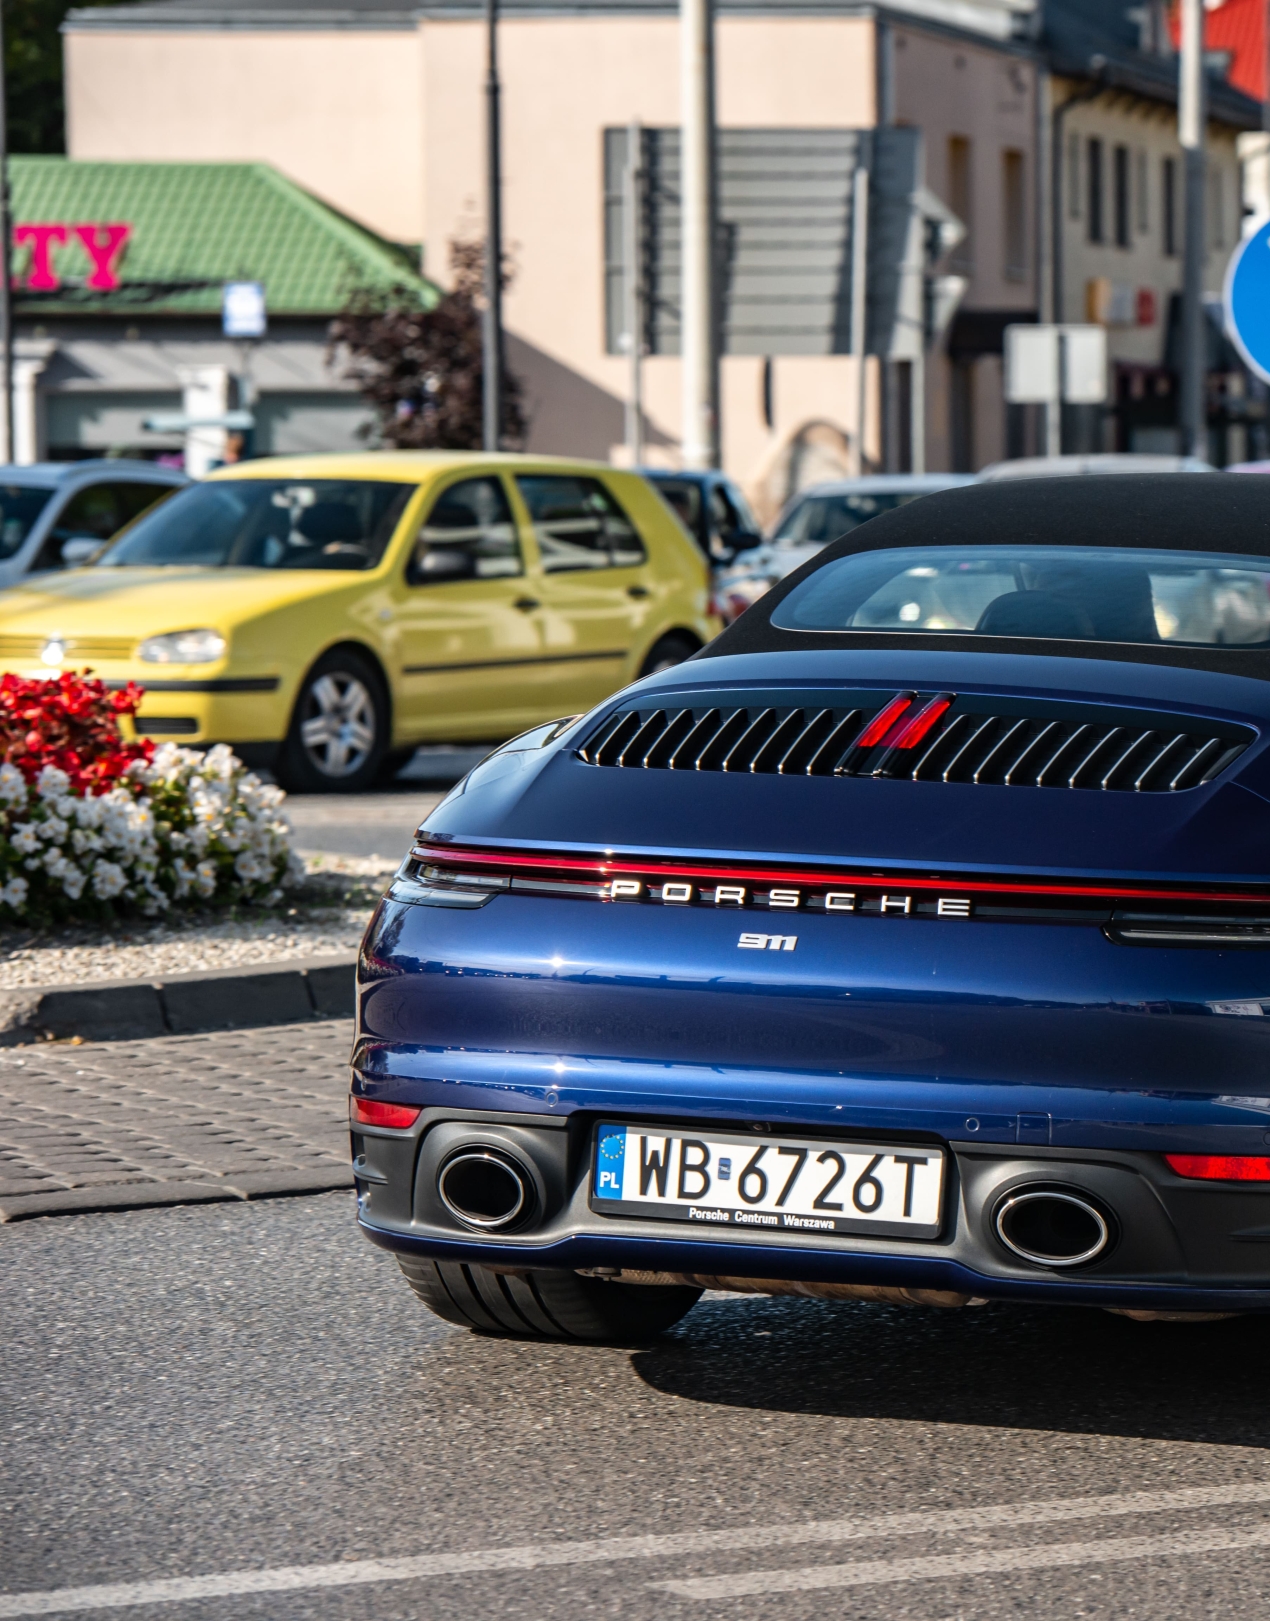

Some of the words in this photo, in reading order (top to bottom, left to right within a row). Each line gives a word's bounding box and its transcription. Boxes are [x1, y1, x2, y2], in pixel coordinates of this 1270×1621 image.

[2, 221, 133, 291] TY
[611, 880, 970, 916] PORSCHE
[737, 932, 798, 951] 911
[600, 1171, 619, 1189] PL
[639, 1136, 711, 1200] WB
[738, 1145, 928, 1218] 6726T
[689, 1208, 729, 1222] Porsche
[735, 1211, 777, 1225] Centrum
[783, 1215, 835, 1230] Warszawa
